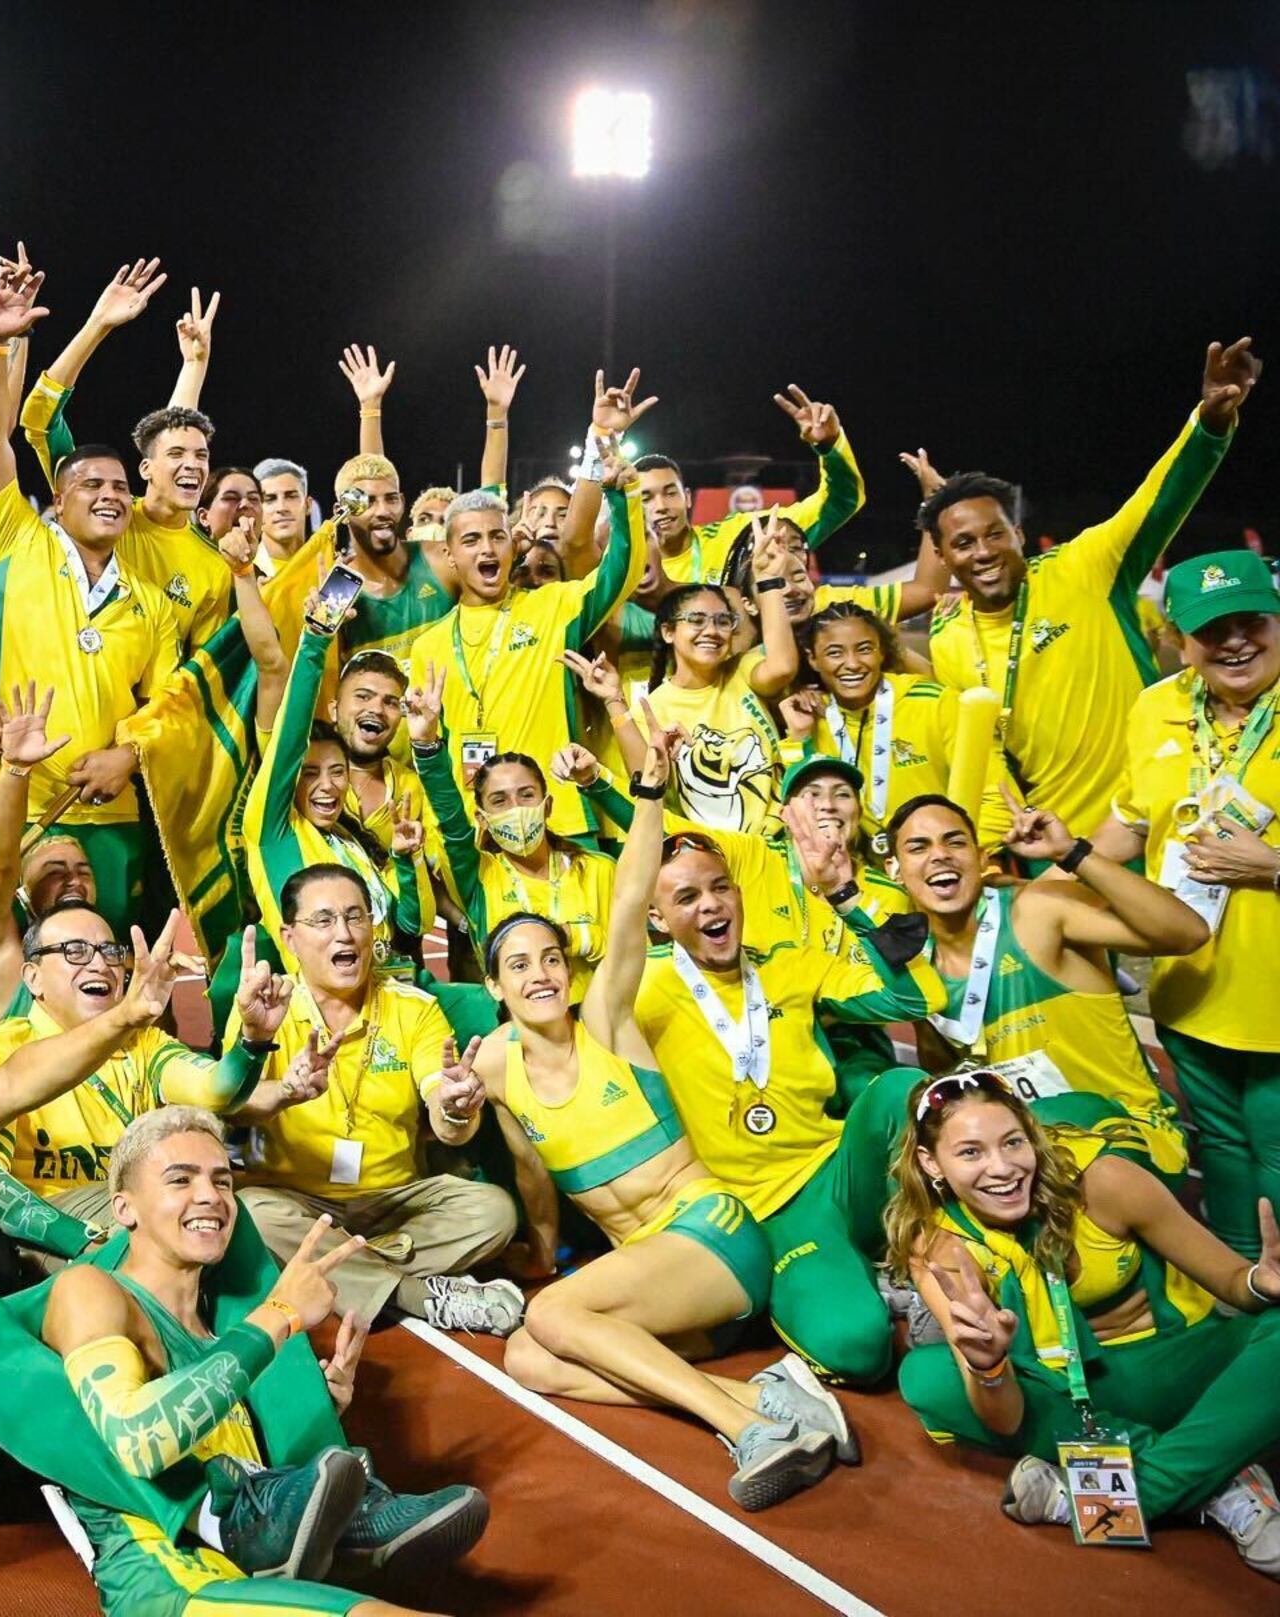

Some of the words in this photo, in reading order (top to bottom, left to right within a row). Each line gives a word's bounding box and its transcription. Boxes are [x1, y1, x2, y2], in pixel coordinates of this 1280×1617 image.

[508, 635, 539, 651] INTER
[1032, 623, 1070, 654] INTER
[369, 1061, 408, 1074] INTER
[773, 1241, 819, 1274] INTER
[1111, 1472, 1128, 1492] A
